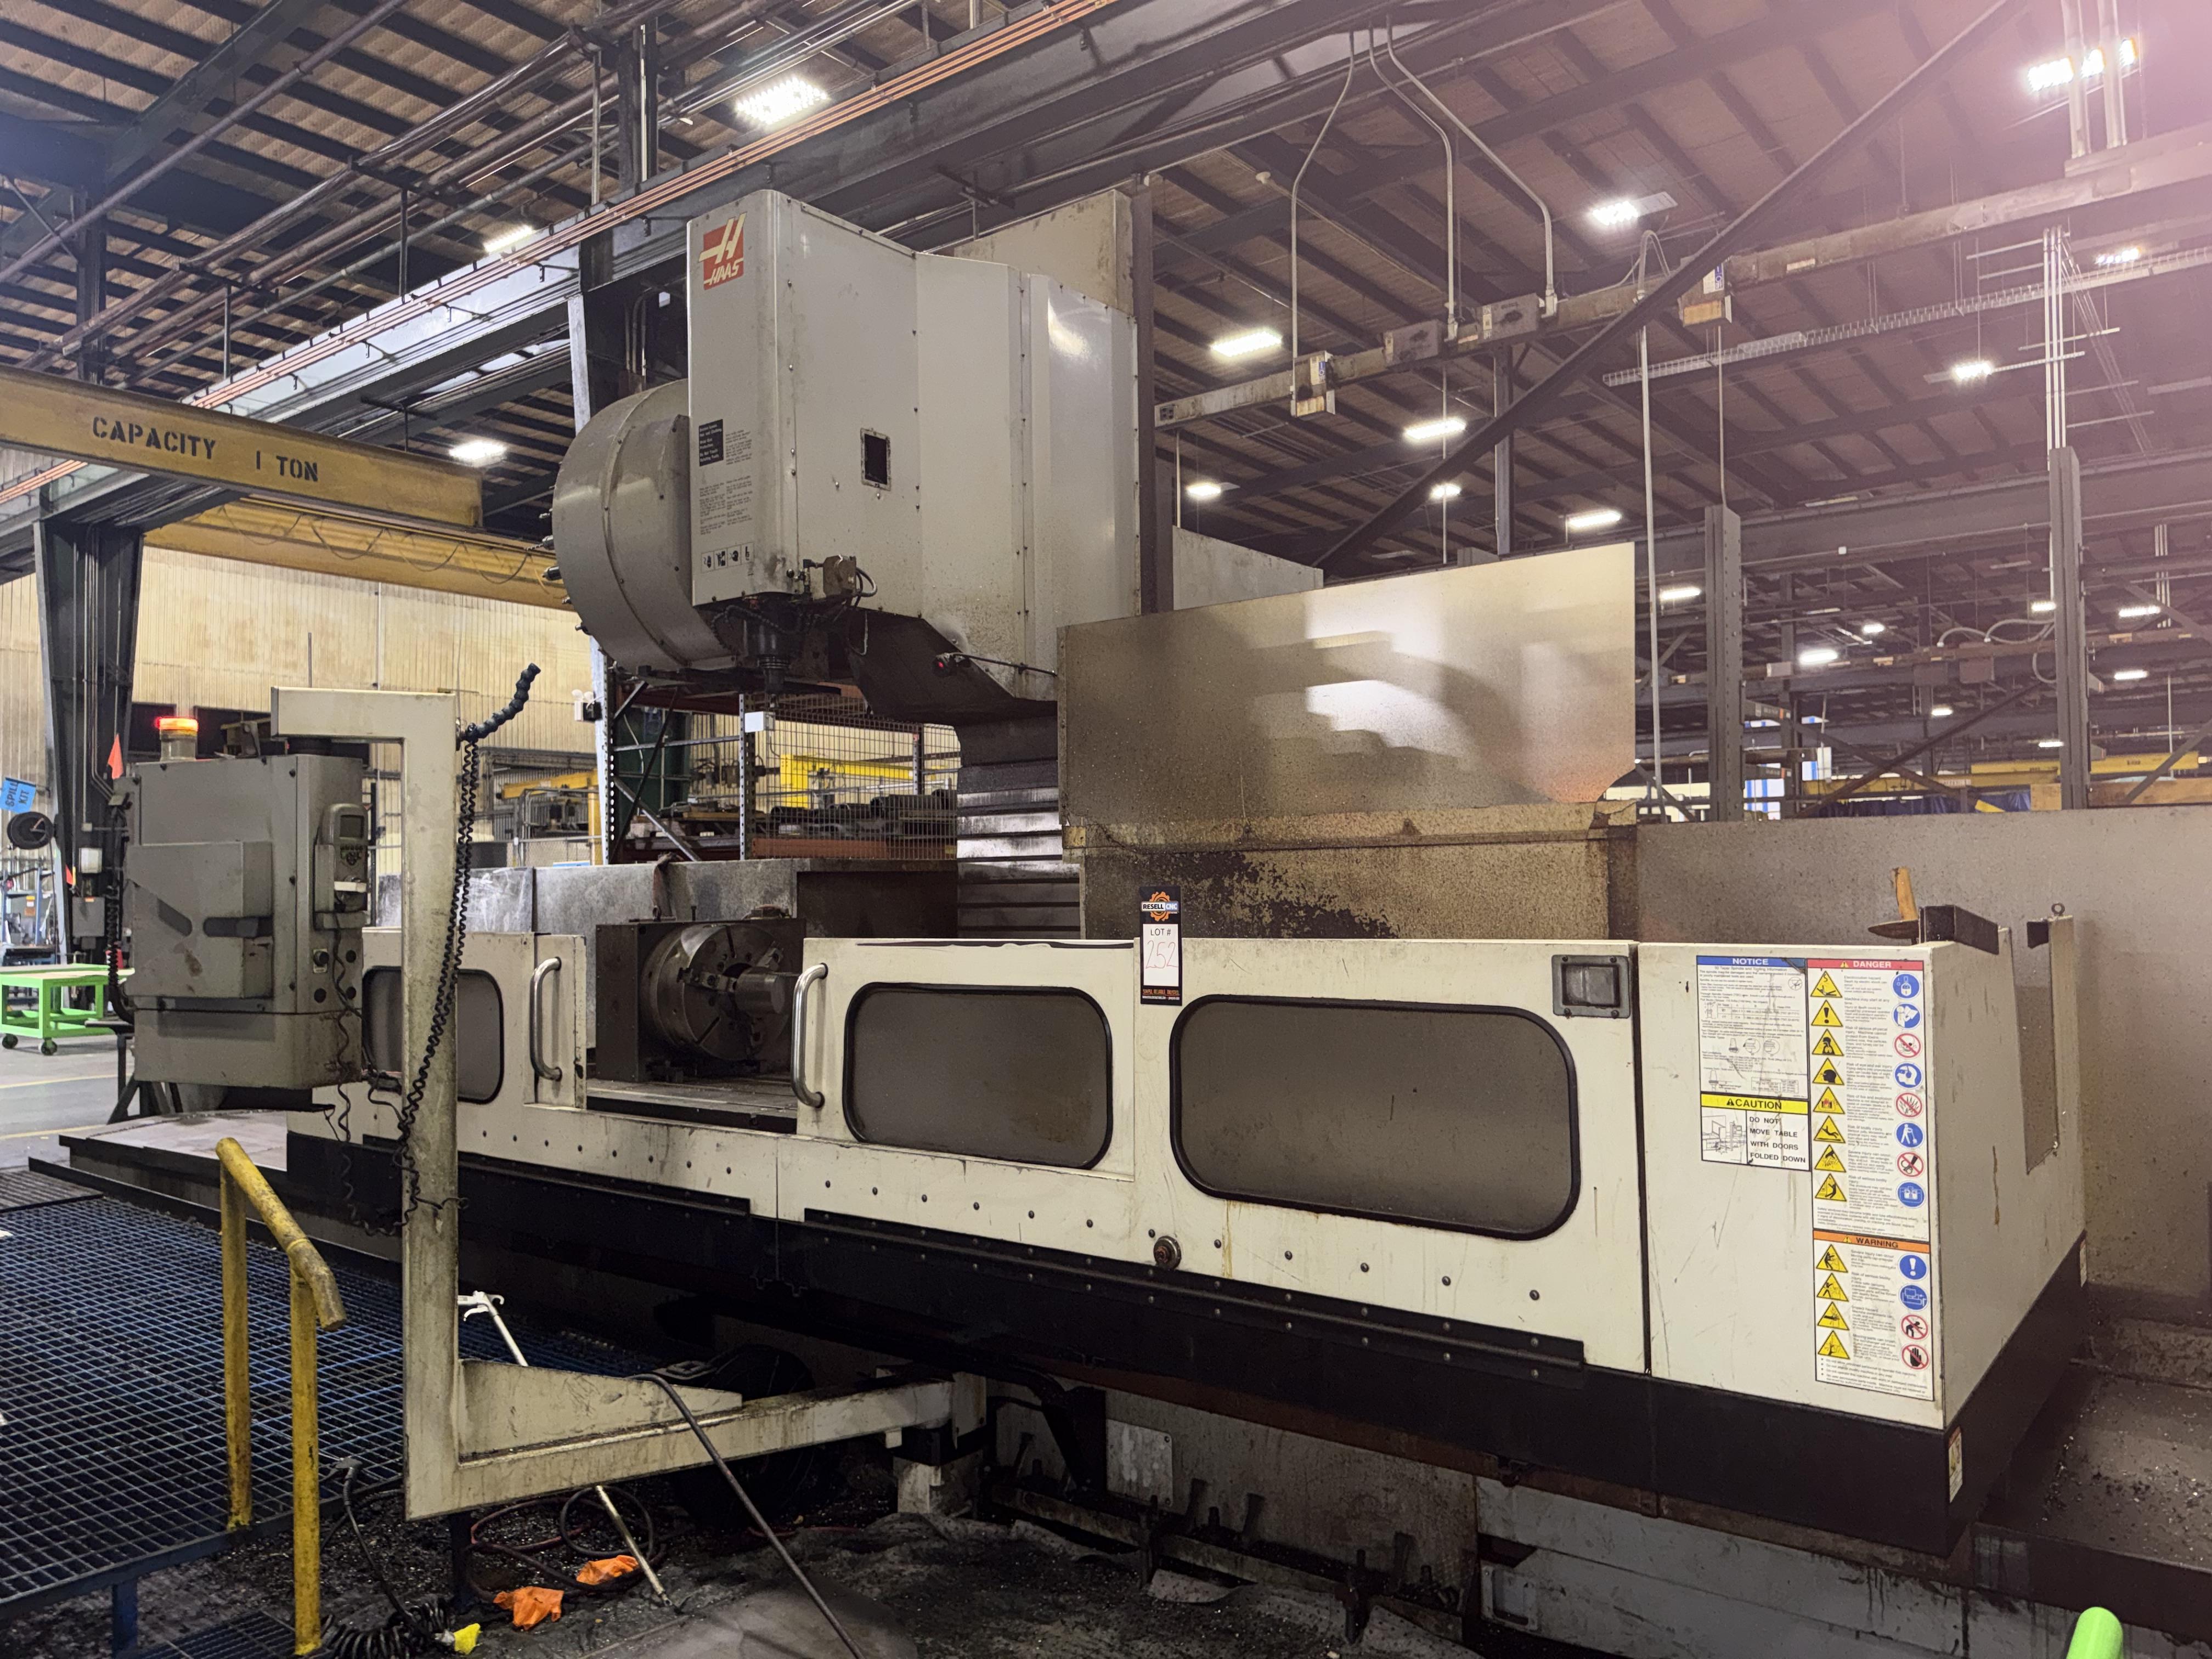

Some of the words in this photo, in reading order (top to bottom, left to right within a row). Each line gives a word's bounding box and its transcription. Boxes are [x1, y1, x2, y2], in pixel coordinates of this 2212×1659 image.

[704, 257, 744, 285] HAAS
[93, 417, 216, 459] CAPACITY
[276, 455, 318, 482] TON
[5, 781, 18, 807] SPILL
[18, 790, 30, 804] KIT
[1167, 928, 1171, 936] #
[1145, 940, 1178, 969] 252
[1732, 957, 1769, 966] NOTICE
[1735, 1099, 1782, 1110] CAUTION
[1856, 1237, 1898, 1248] WARNING
